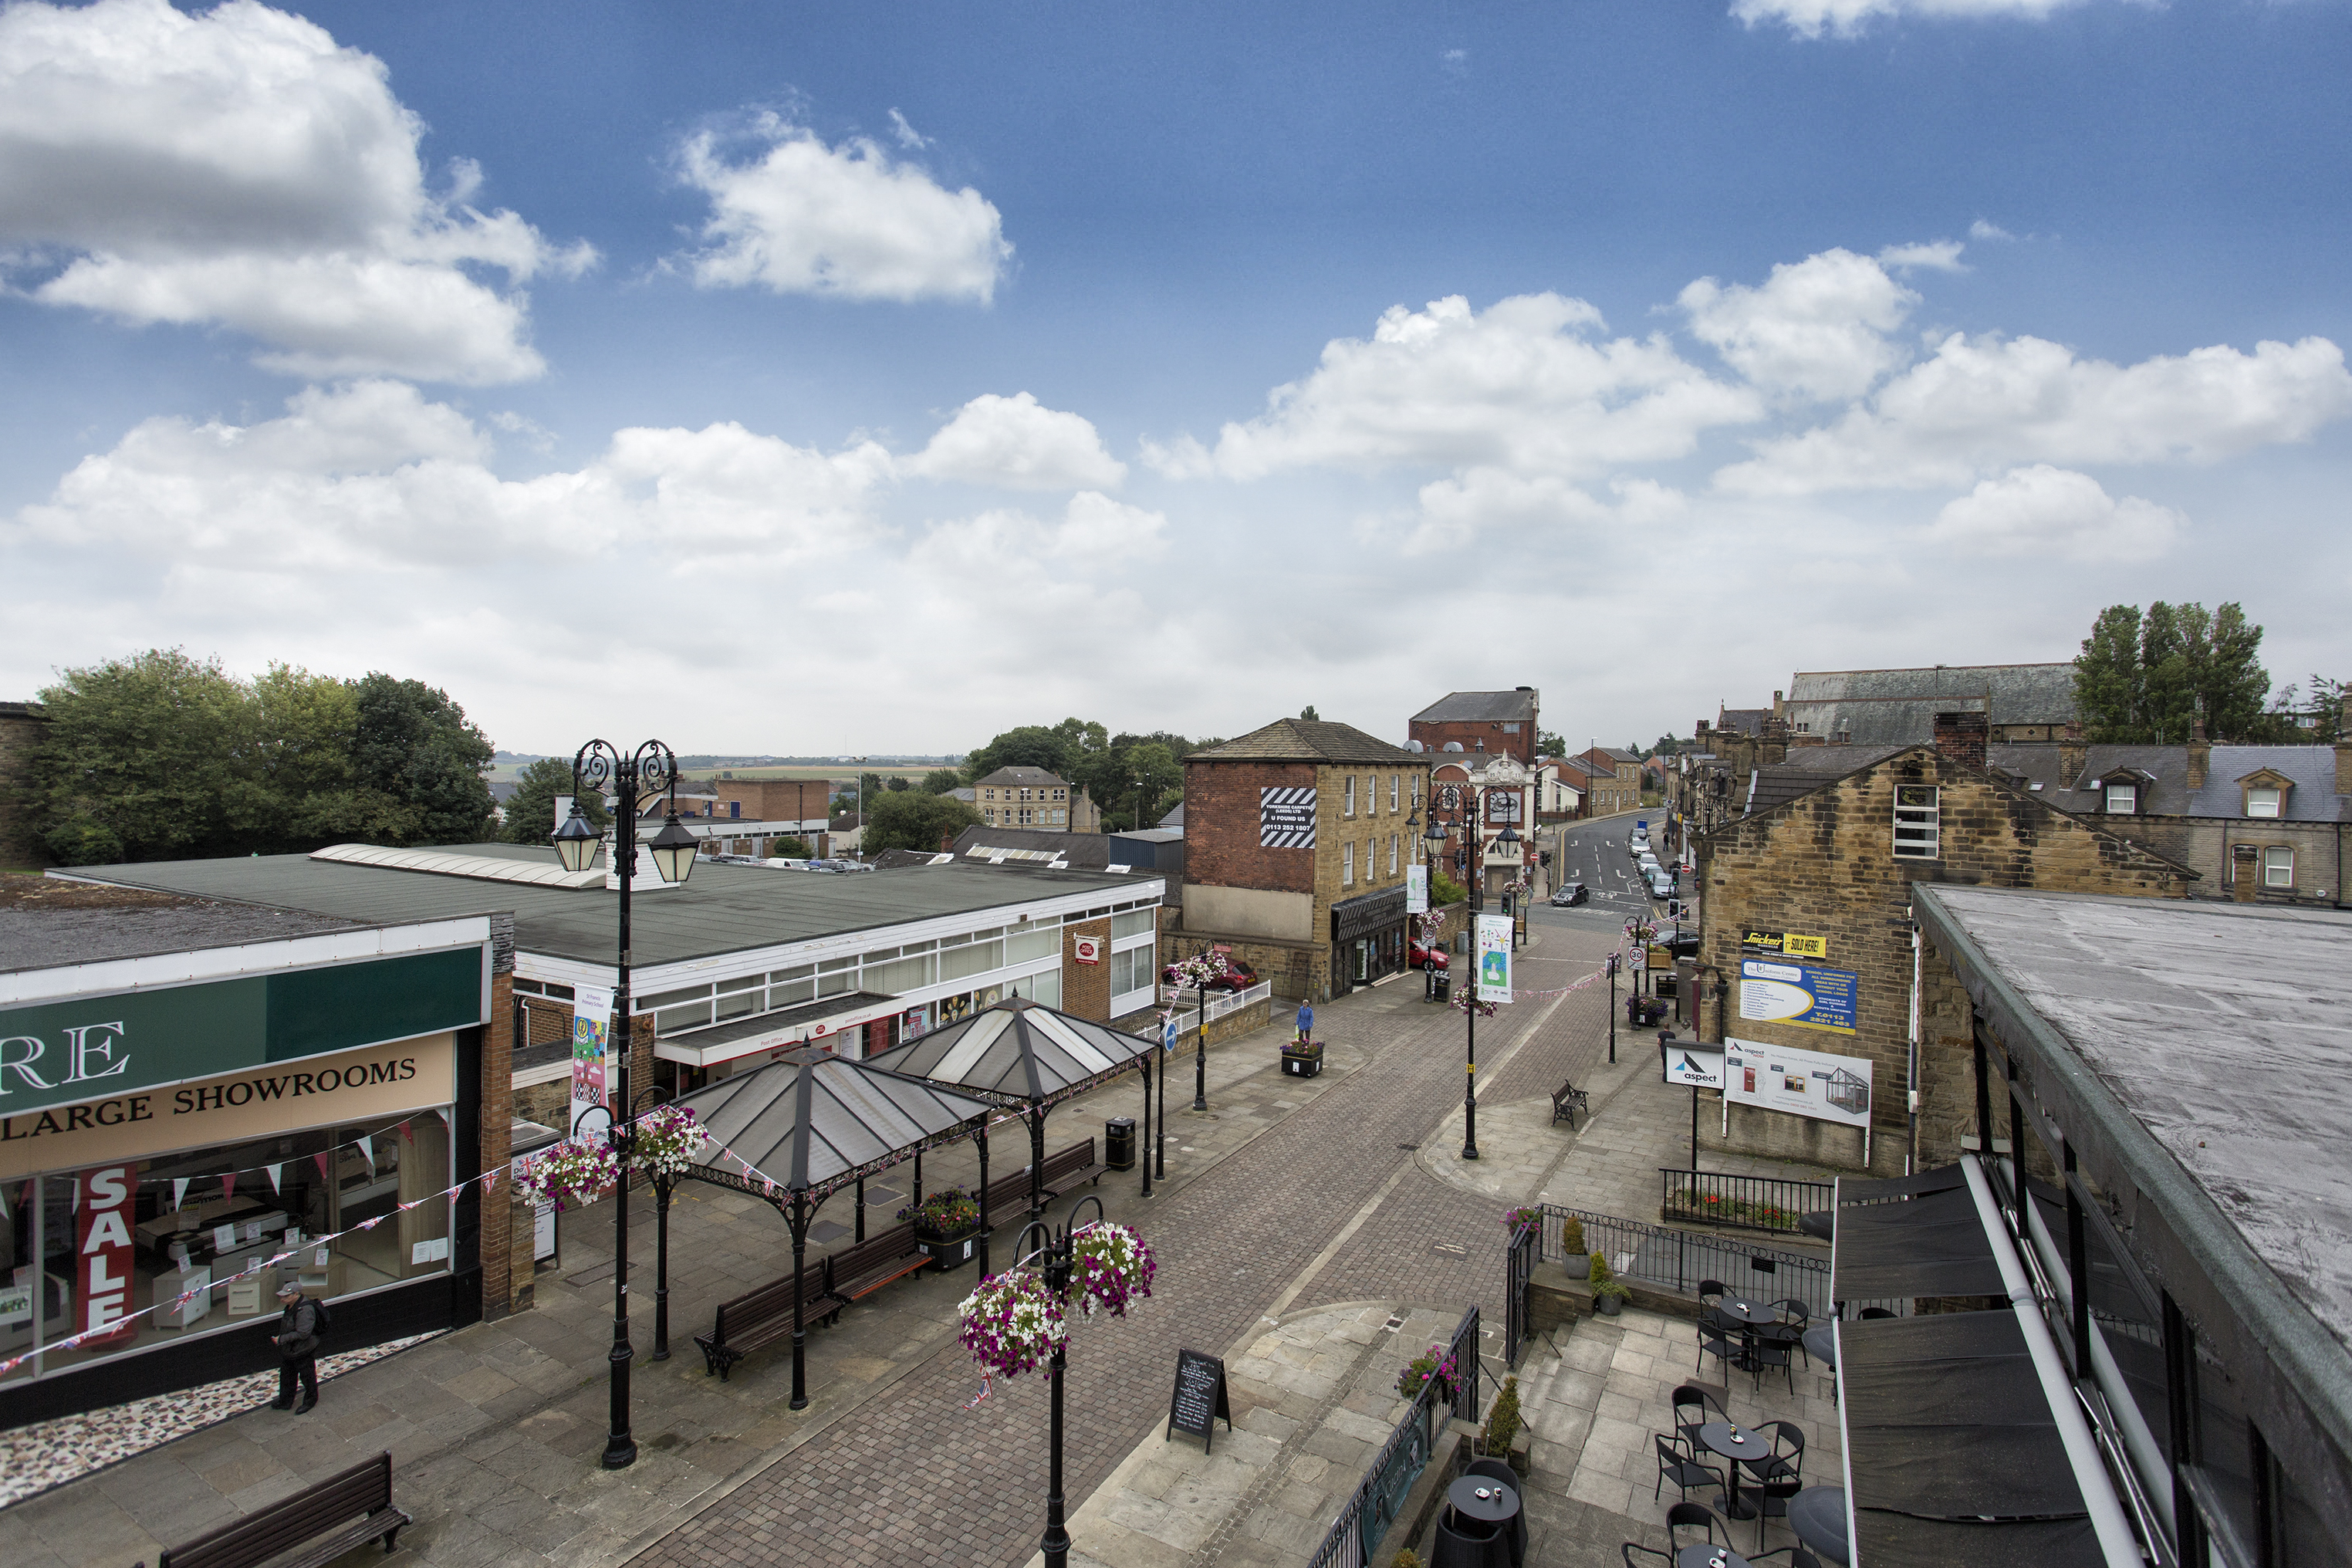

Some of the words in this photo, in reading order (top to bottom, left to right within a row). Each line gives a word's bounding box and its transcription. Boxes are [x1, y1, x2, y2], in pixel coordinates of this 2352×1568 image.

[1790, 938, 1804, 951] SOLD
[1804, 940, 1820, 952] HERE!
[1756, 964, 1781, 974] Uniform
[845, 1012, 872, 1023] postoffice.co.uk
[1816, 1012, 1844, 1020] T.0113
[1685, 1073, 1718, 1082] aspect
[2, 1096, 153, 1141] LARGE
[174, 1058, 416, 1114] SHOWROOMS
[83, 1168, 132, 1337] SALE
